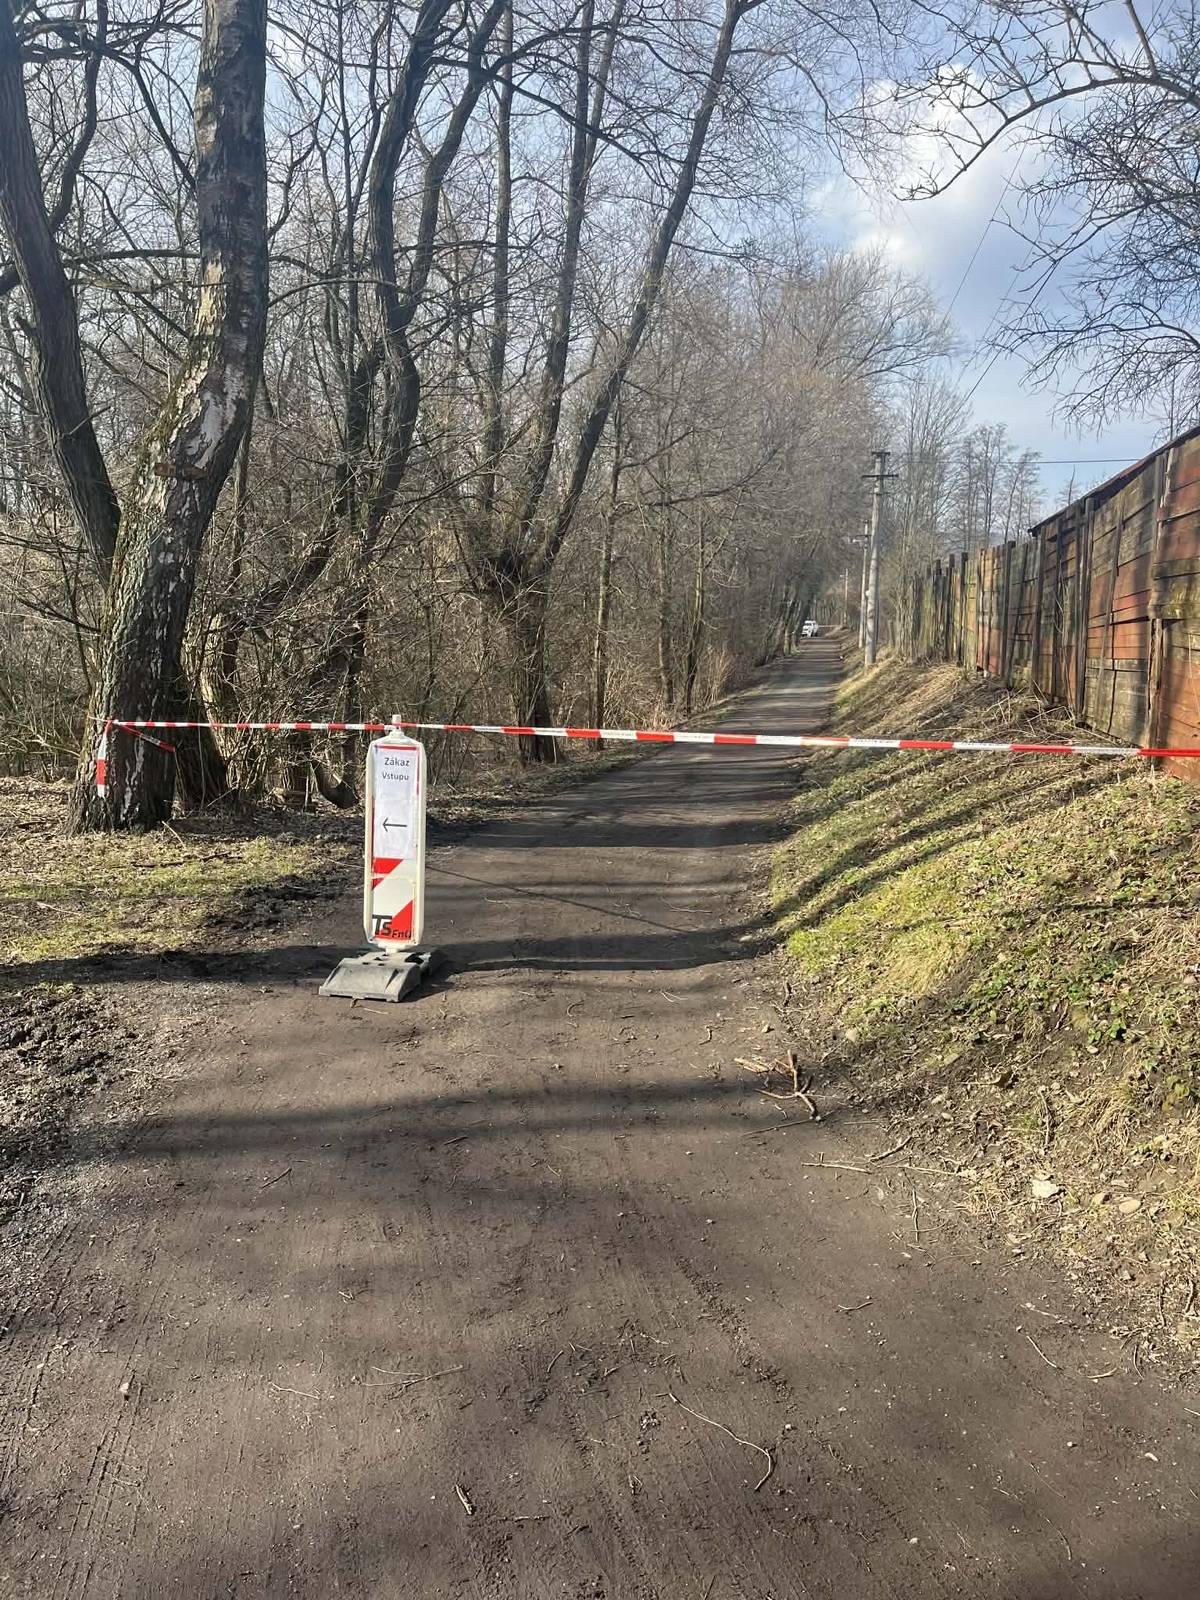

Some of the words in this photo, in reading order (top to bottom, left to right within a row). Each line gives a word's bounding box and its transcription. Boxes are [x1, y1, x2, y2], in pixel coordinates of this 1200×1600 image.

[384, 756, 410, 767] Zákaz
[382, 772, 409, 782] Vstupu
[372, 914, 393, 936] TS
